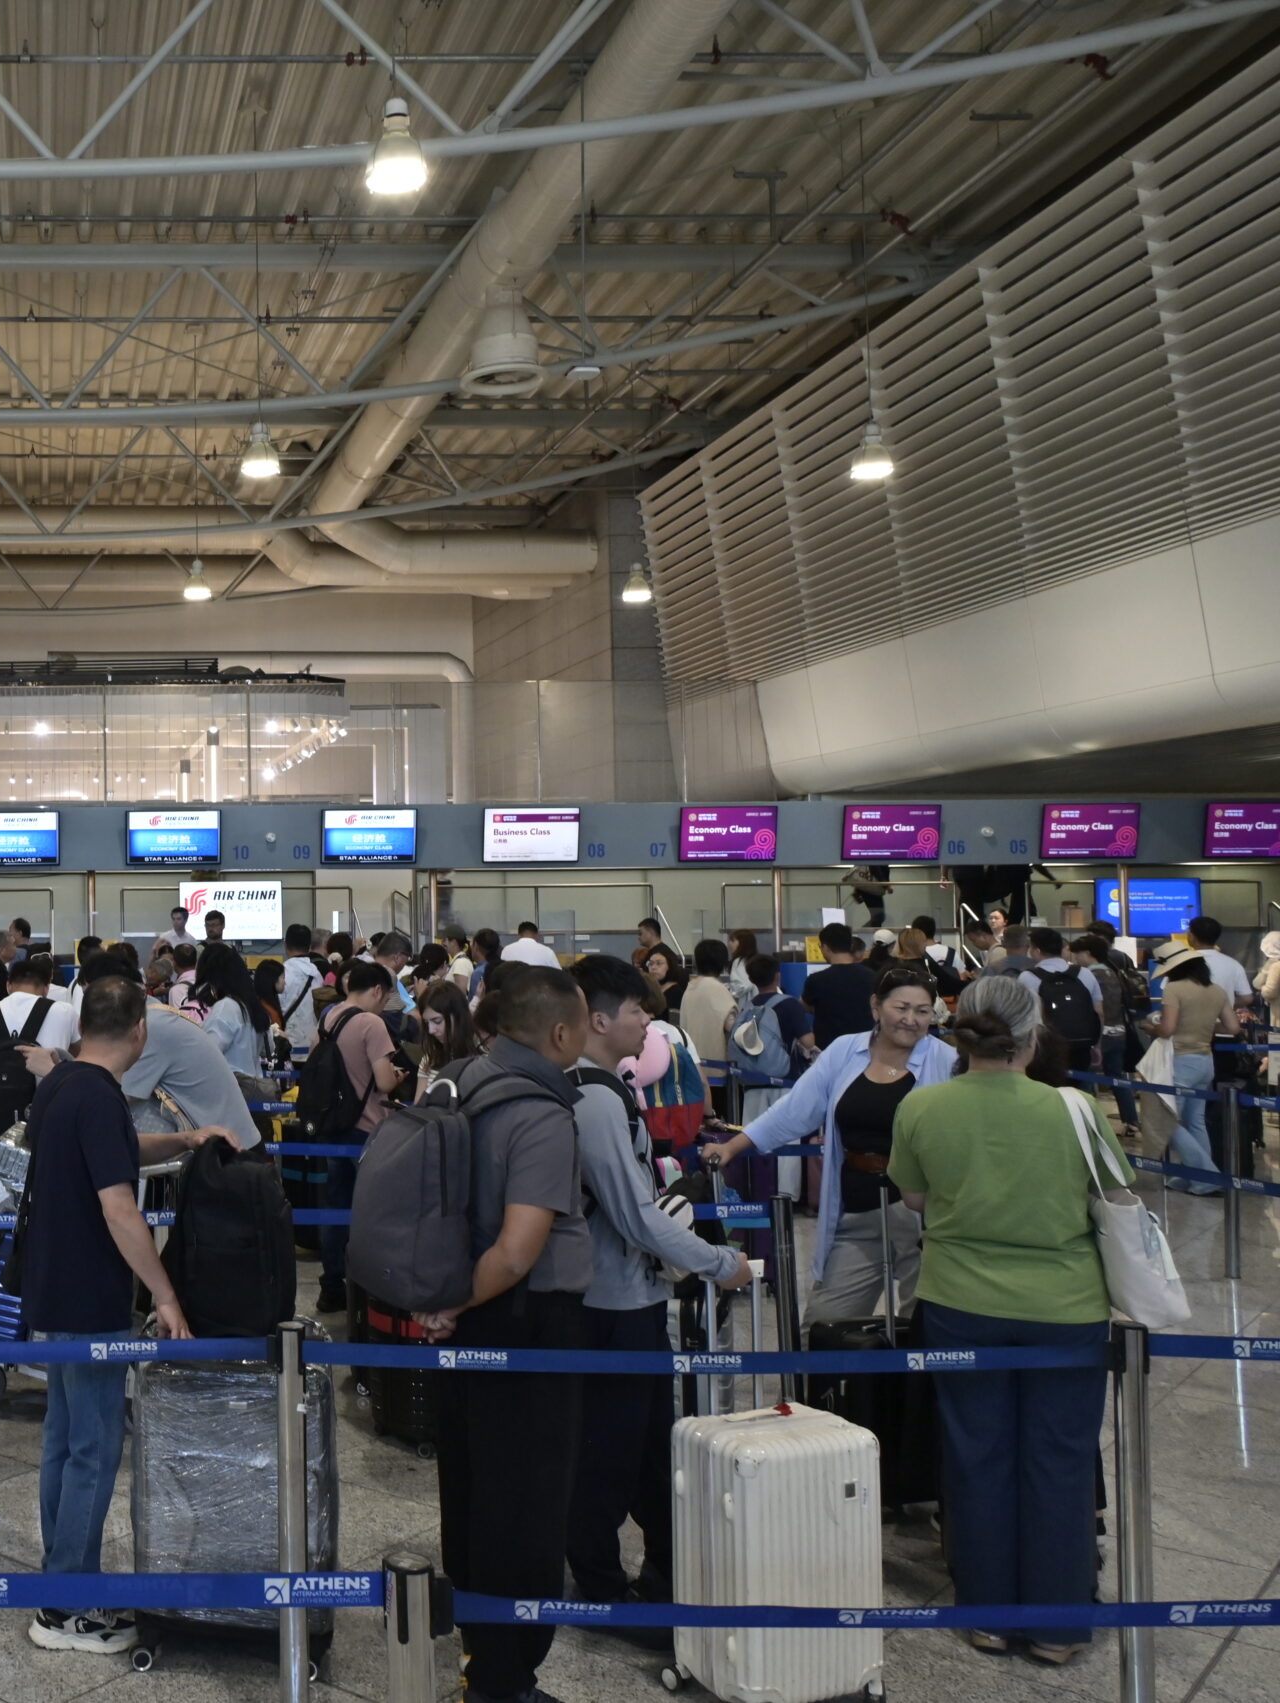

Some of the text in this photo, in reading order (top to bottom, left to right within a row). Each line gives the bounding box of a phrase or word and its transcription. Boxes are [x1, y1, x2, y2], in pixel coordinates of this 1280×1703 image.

[689, 825, 751, 835] Economy Class
[852, 824, 915, 833] Economy Class
[1051, 822, 1113, 832] Economy Class
[1214, 822, 1277, 831] Economy Class
[493, 828, 528, 836] Business
[293, 845, 310, 859] 09
[587, 843, 605, 857] 08
[650, 843, 667, 857] 07
[948, 840, 965, 855] 06
[1010, 840, 1027, 854] 05
[233, 845, 249, 860] 10
[213, 890, 277, 900] AIR CHINA
[729, 1205, 763, 1213] ATHENS
[109, 1342, 158, 1351] ATHENS
[1252, 1341, 1280, 1350] ATH
[458, 1351, 508, 1361] ATHENS
[692, 1355, 742, 1364] ATHENS
[926, 1351, 975, 1361] ATHENS
[293, 1577, 370, 1590] ATHENS
[542, 1601, 612, 1611] ATHENS
[1199, 1603, 1272, 1613] ATHENS
[867, 1608, 939, 1616] ATHENS
